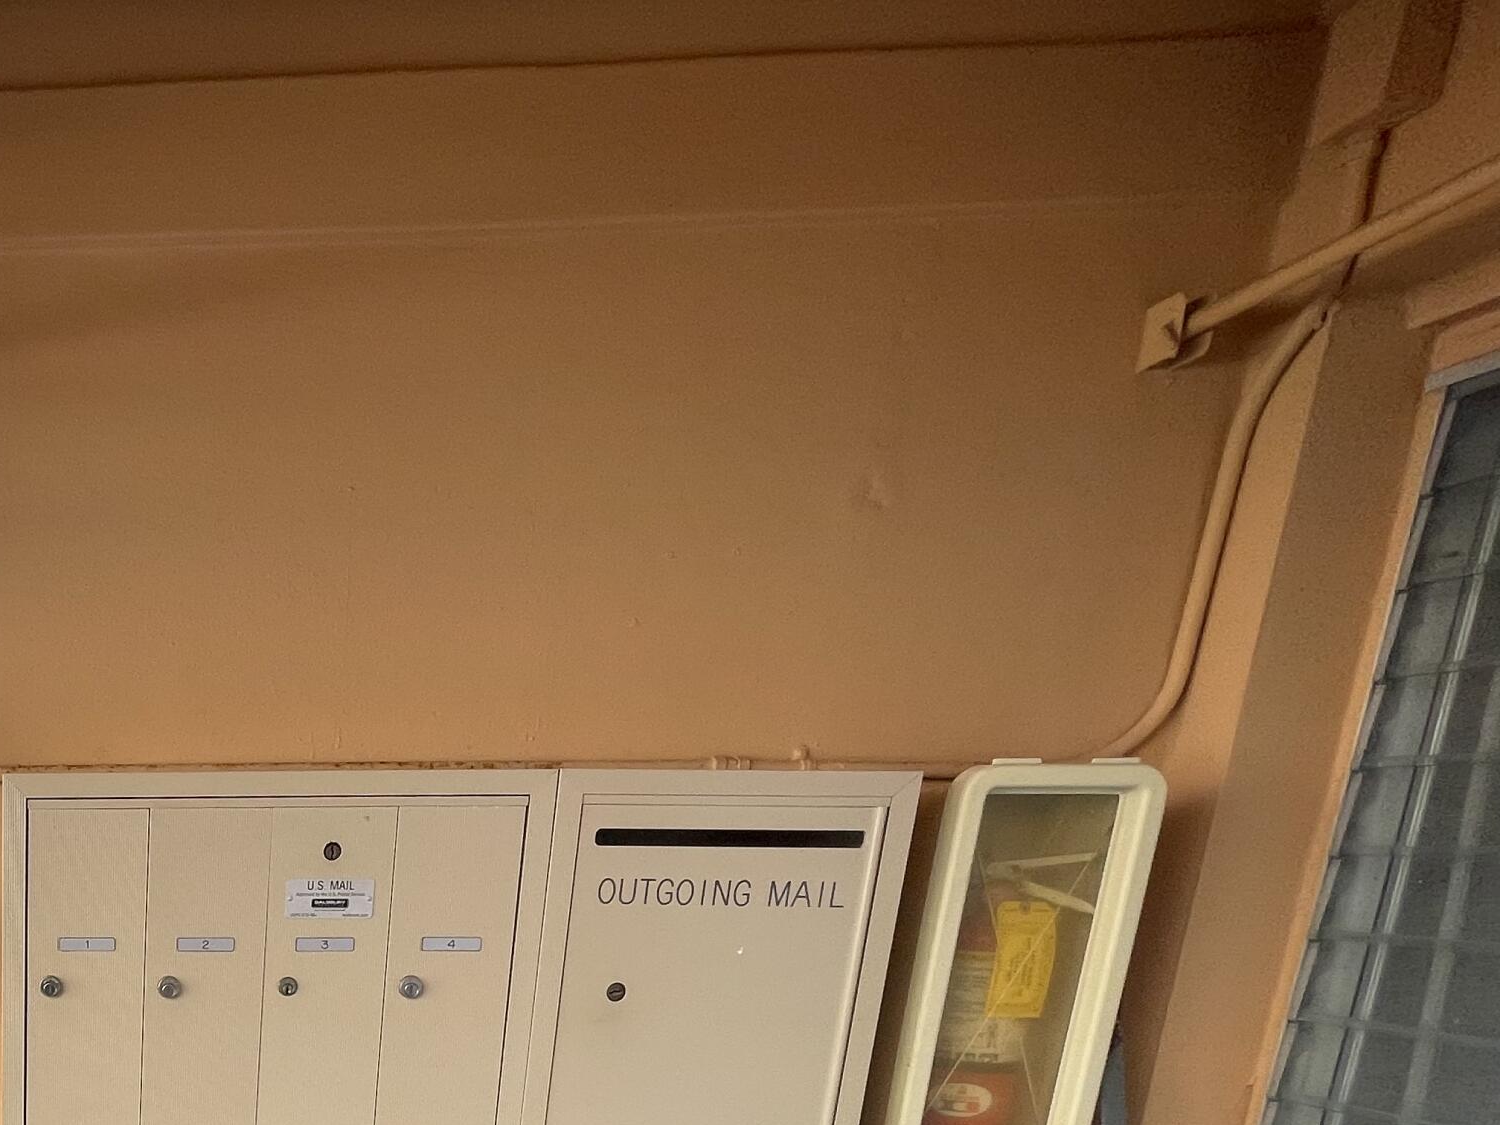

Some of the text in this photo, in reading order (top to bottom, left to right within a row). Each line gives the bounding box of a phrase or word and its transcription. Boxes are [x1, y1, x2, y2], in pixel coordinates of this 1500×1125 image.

[330, 880, 354, 891] MAIL
[597, 877, 845, 908] OUTGOING MAIL
[85, 940, 90, 949] 1
[202, 940, 210, 949] 2
[321, 940, 329, 949] 3
[447, 940, 456, 949] 4
